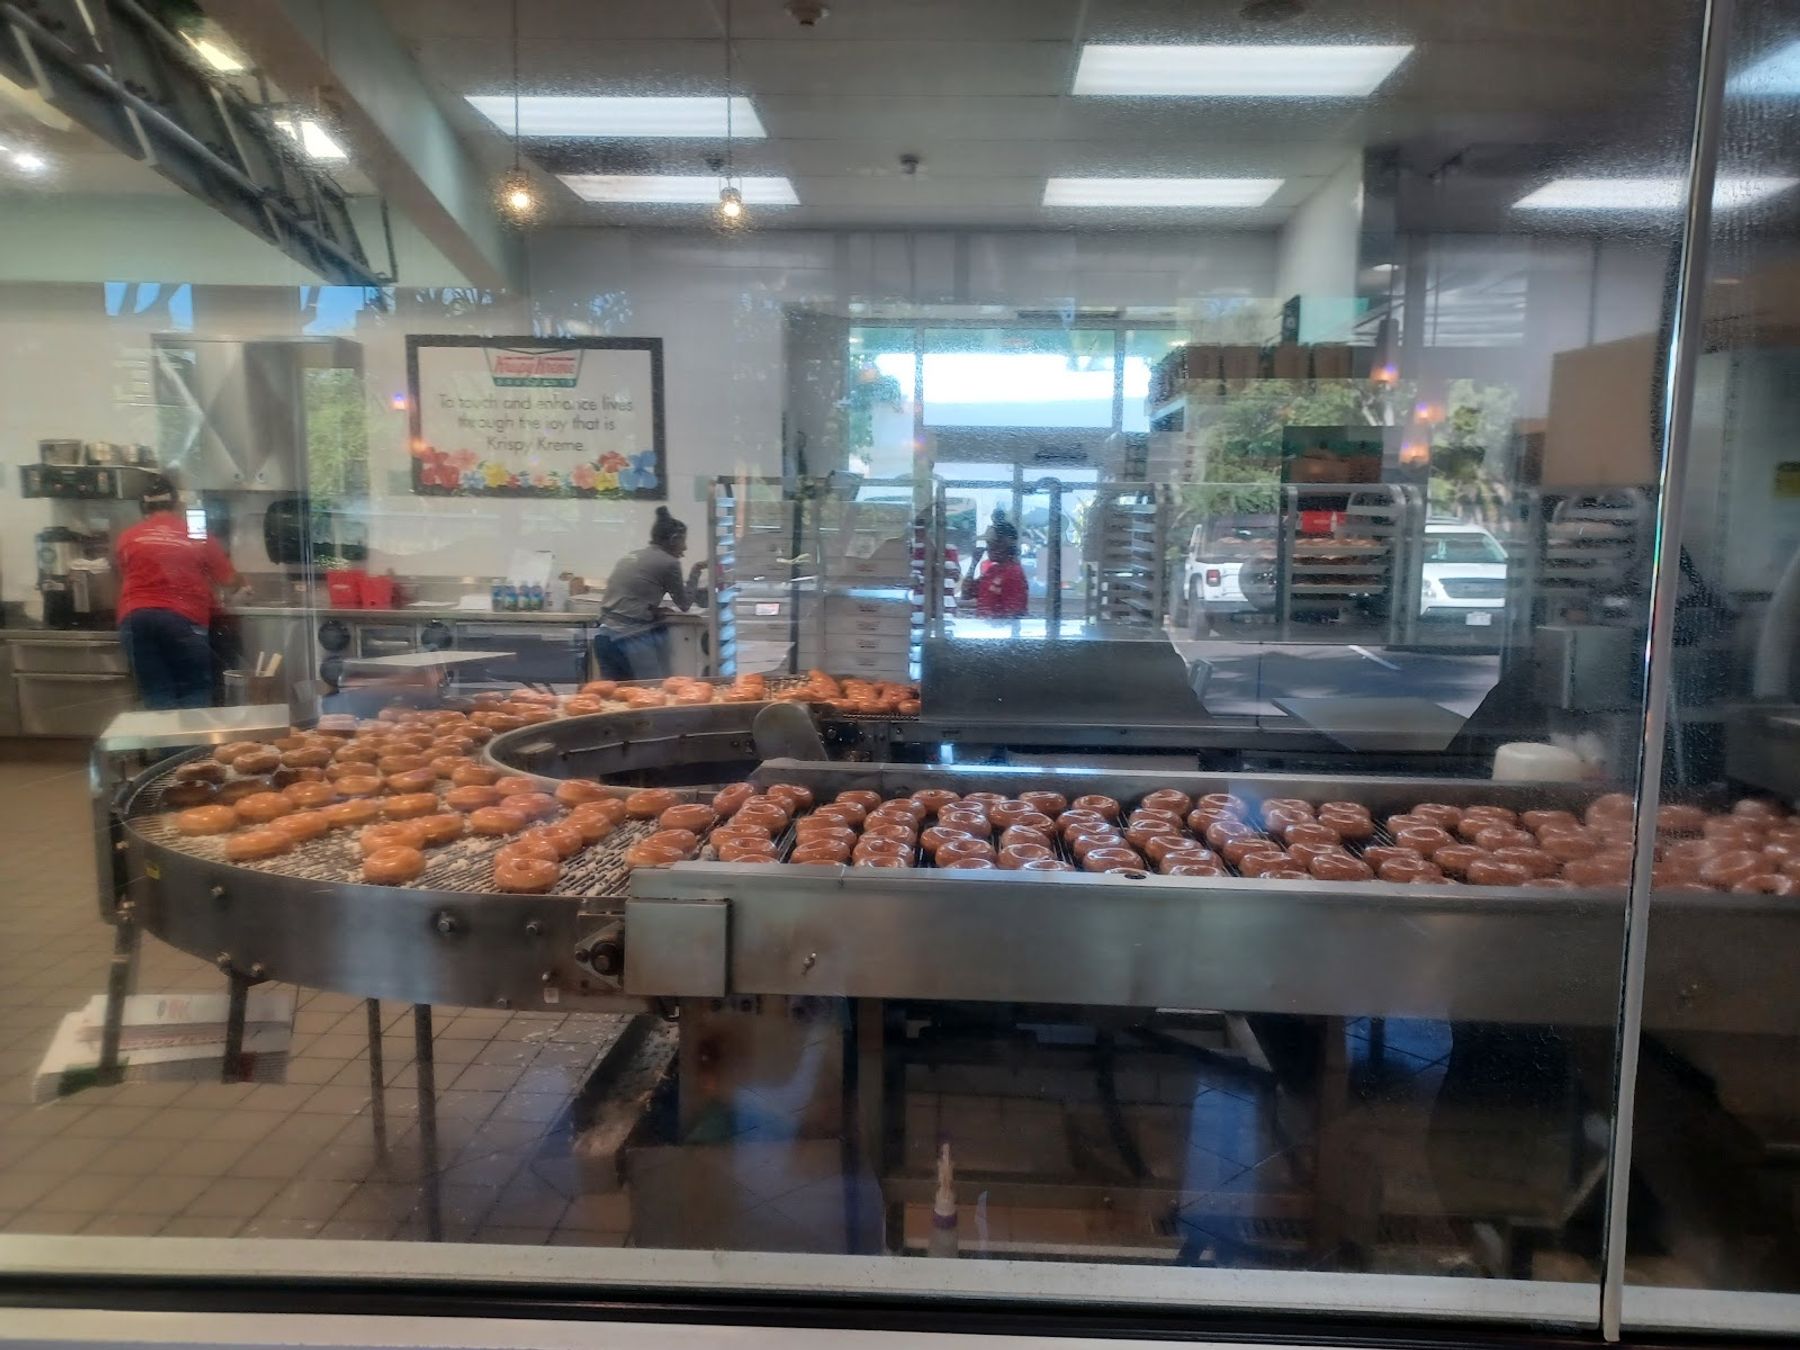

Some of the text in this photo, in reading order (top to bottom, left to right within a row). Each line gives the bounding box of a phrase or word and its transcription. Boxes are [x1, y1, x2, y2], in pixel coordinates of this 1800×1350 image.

[439, 393, 454, 409] To
[503, 394, 531, 410] and
[602, 394, 633, 411] lives
[519, 414, 540, 429] the
[572, 414, 599, 430] that
[604, 416, 616, 430] is
[487, 436, 584, 456] Krispy Kreme
